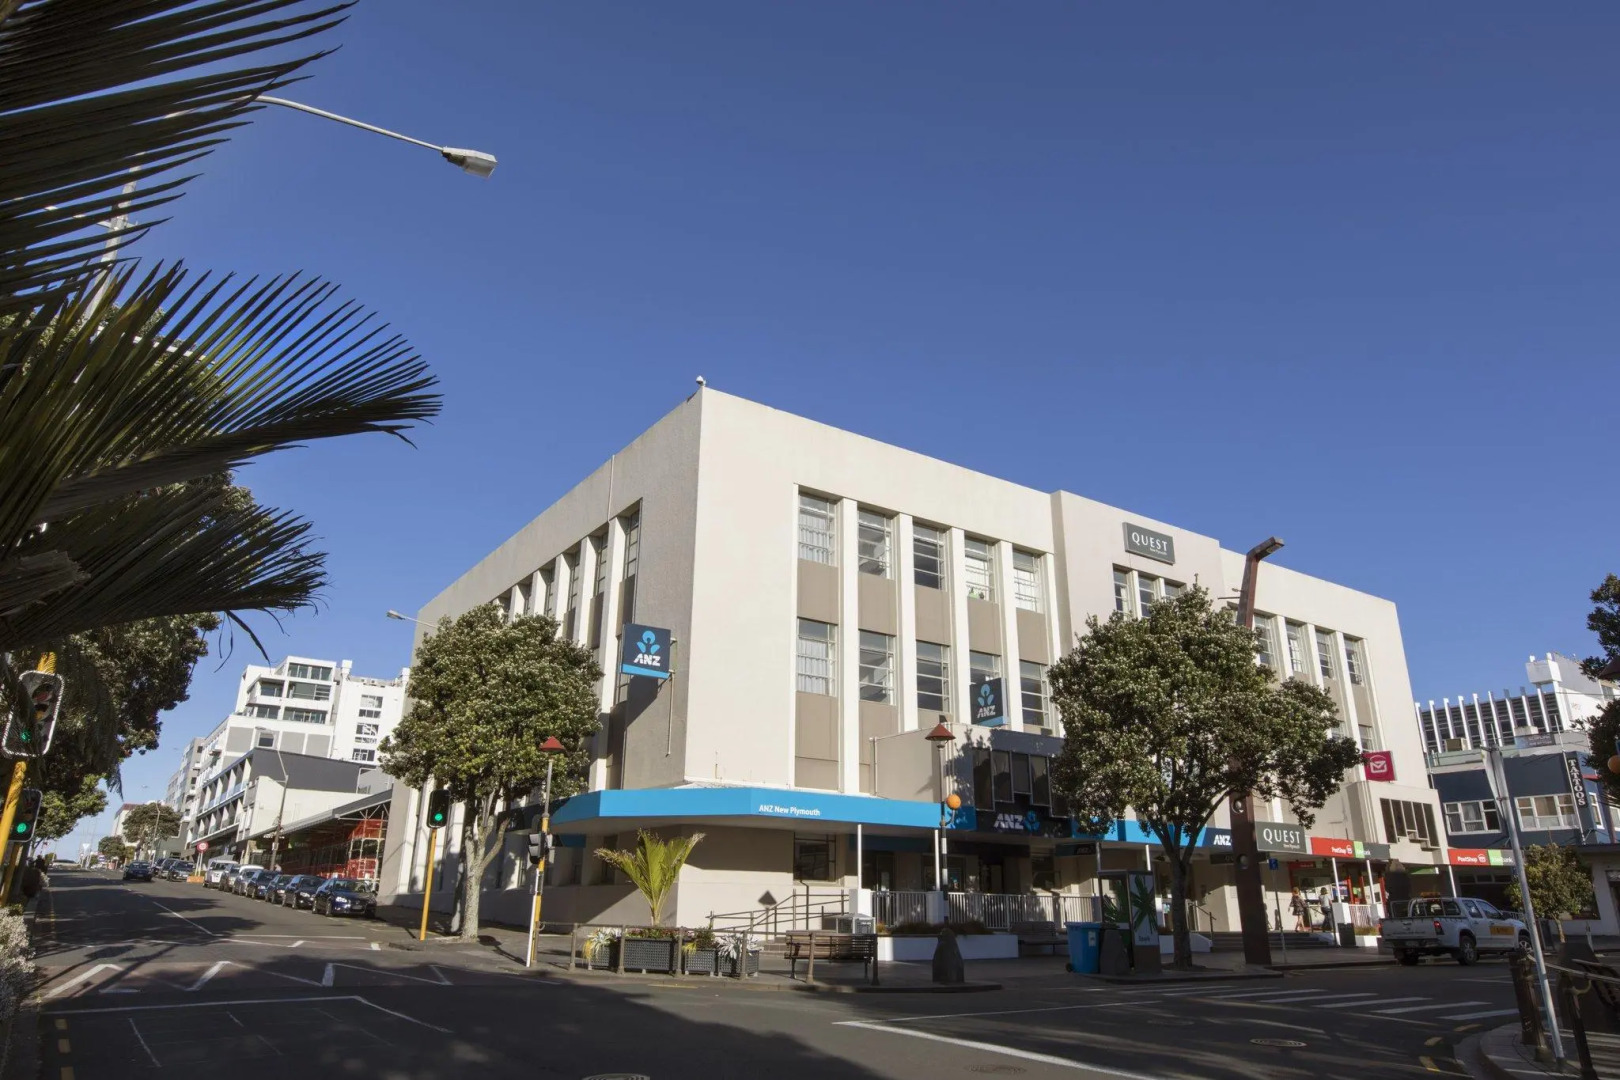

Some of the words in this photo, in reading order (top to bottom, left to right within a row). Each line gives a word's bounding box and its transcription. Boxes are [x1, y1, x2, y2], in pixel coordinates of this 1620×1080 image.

[1131, 531, 1168, 551] QUEST
[633, 653, 661, 667] ANZ
[976, 705, 997, 719] ANZ
[1568, 758, 1586, 806] TATTOOS
[758, 804, 774, 813] ANZ
[774, 805, 789, 814] New
[789, 806, 821, 816] Plymouth
[993, 813, 1025, 830] ANZ
[1213, 834, 1231, 846] ANZ
[1263, 828, 1301, 844] QUEST
